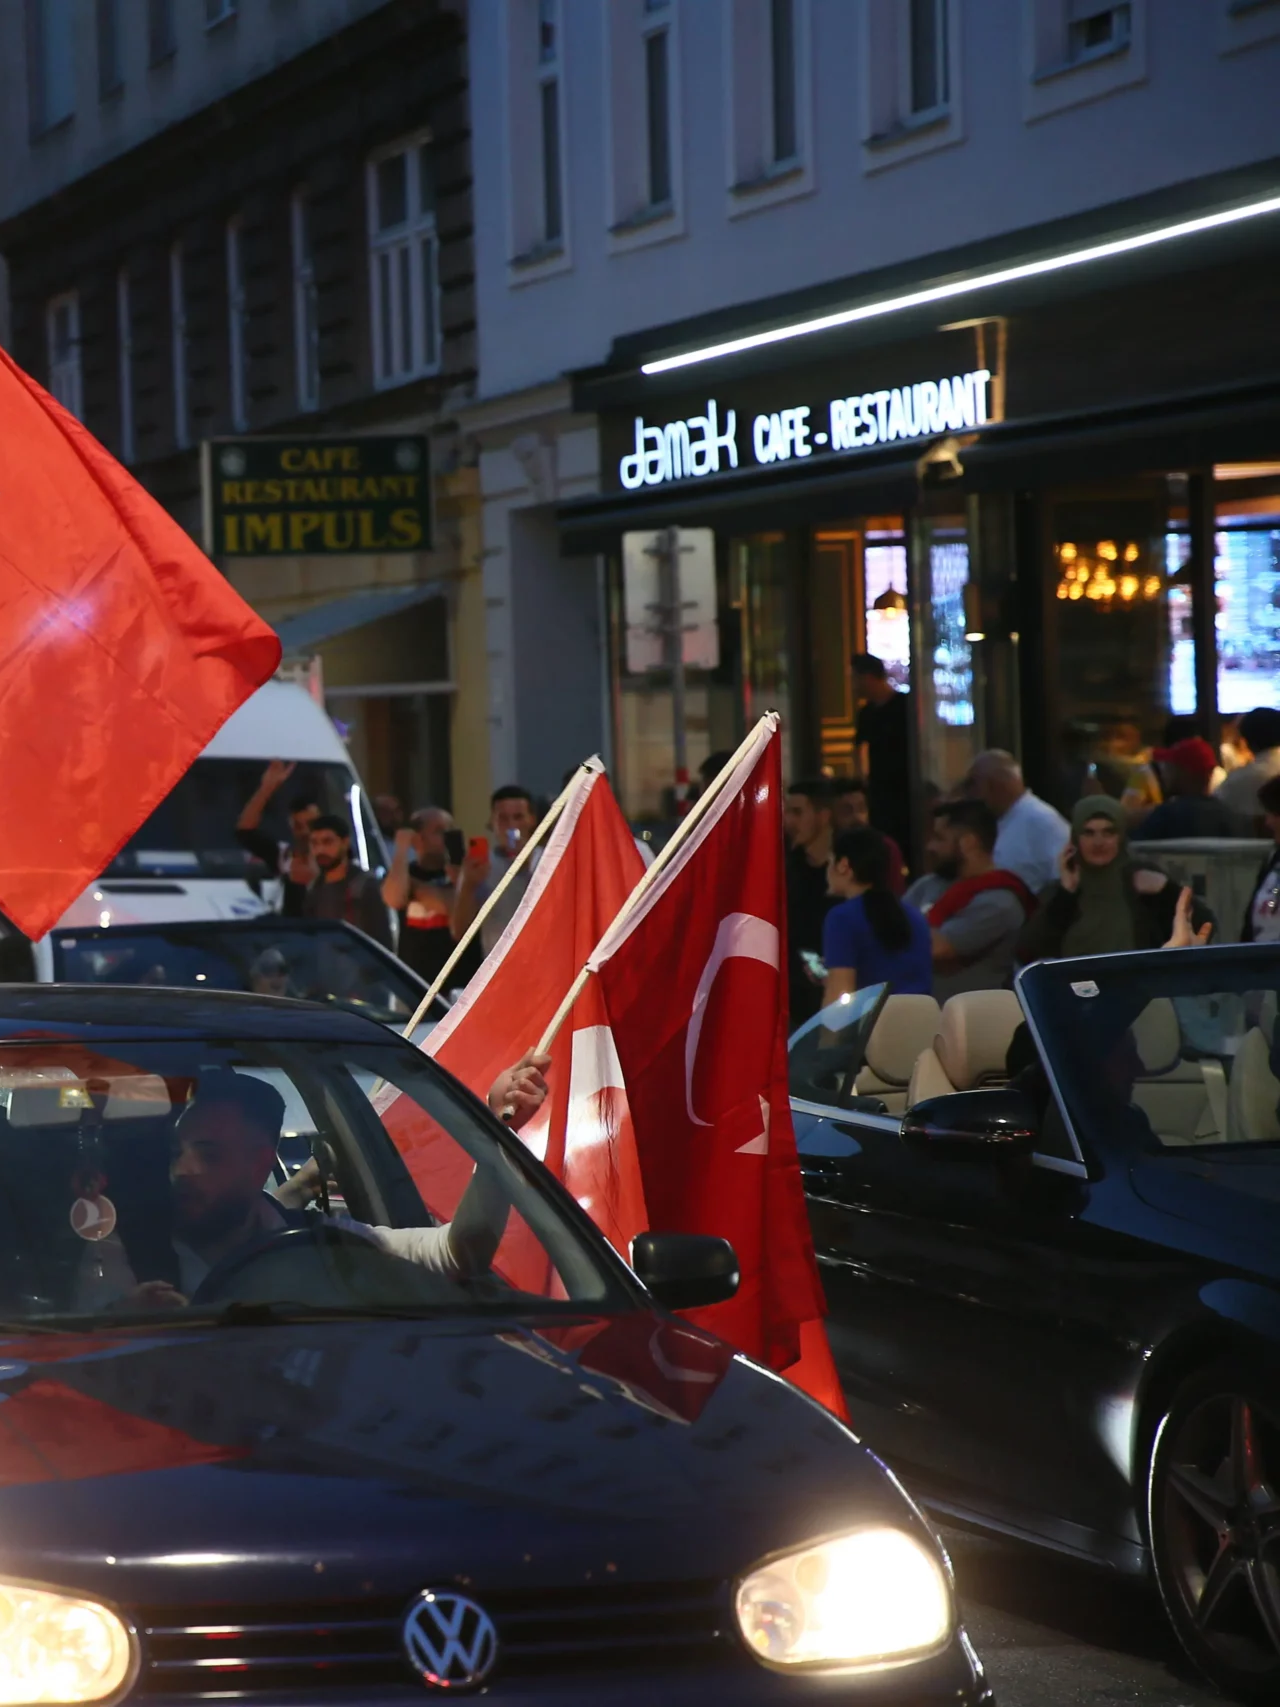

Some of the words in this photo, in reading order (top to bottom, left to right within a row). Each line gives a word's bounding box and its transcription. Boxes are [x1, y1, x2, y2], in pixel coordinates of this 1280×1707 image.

[620, 398, 738, 490] damak
[753, 405, 812, 464] CAFE
[830, 369, 991, 451] RESTAURANT
[280, 446, 359, 472] CAFE
[222, 476, 418, 503] RESTAURANT
[224, 508, 422, 553] IMPULS
